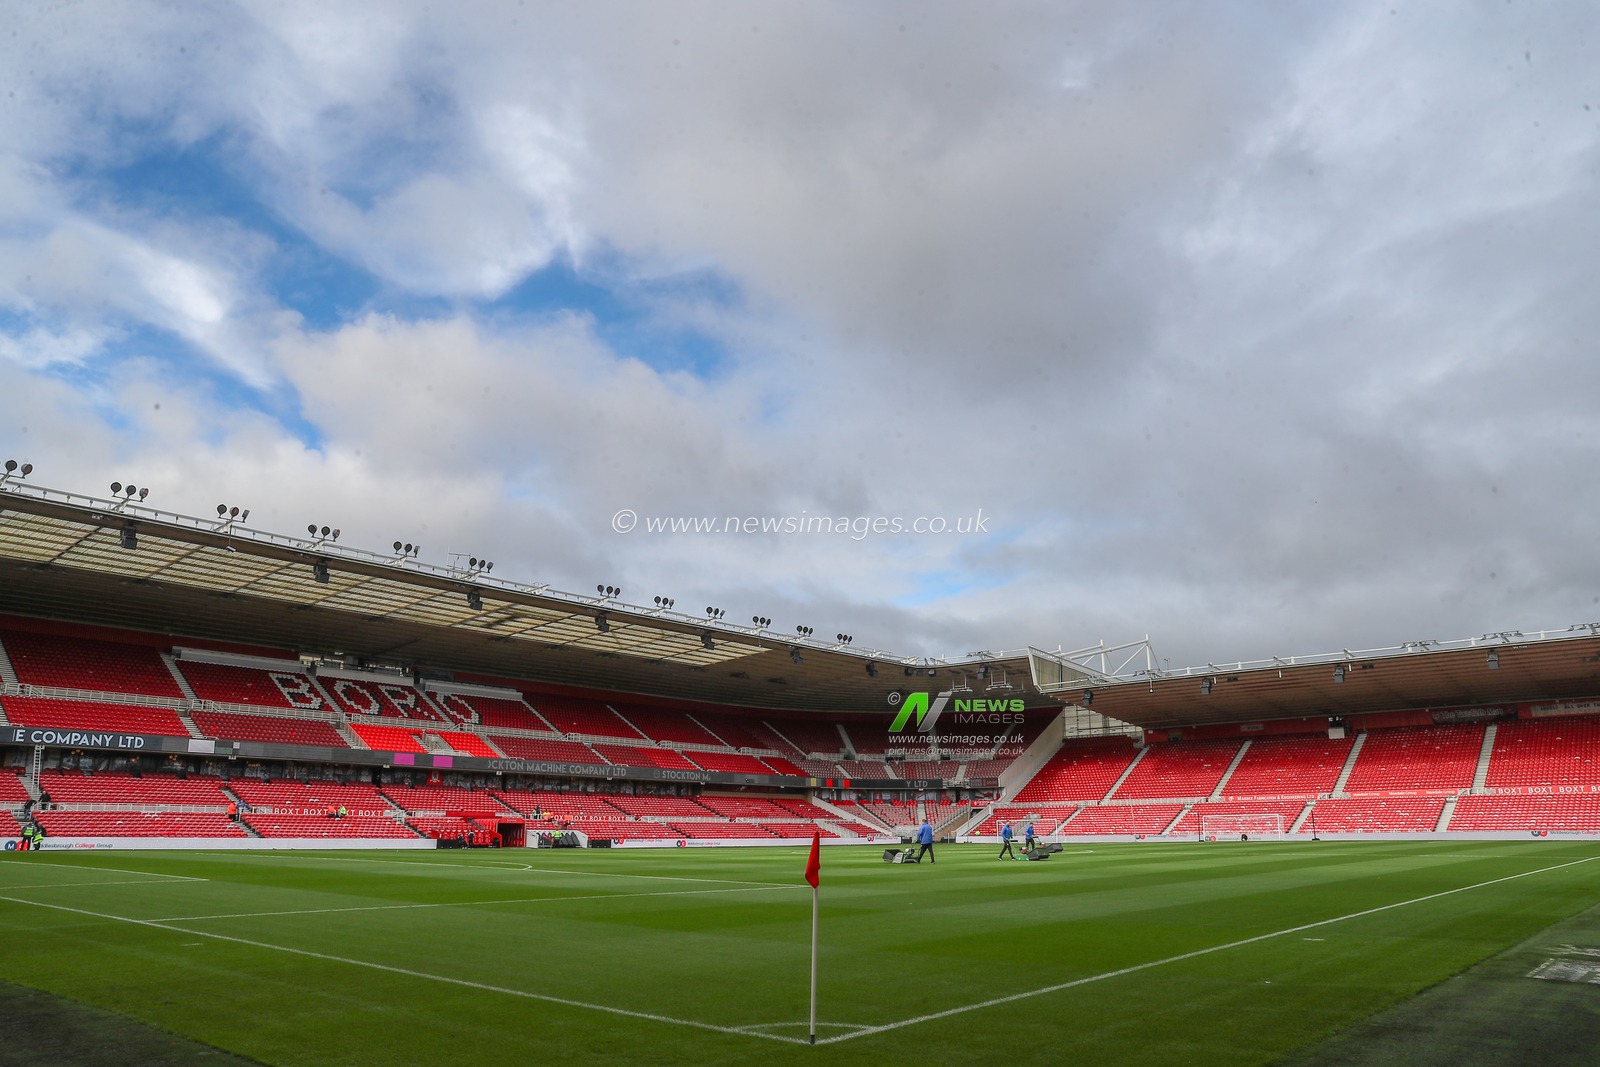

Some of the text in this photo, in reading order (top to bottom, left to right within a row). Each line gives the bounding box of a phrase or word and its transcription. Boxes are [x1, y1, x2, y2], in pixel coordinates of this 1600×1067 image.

[269, 673, 481, 725] BORO
[12, 729, 145, 749] E COMPANY LTD
[526, 762, 567, 775] MACHINE
[569, 765, 610, 777] COMPANY
[612, 767, 627, 777] LTD
[662, 770, 701, 781] STOCKTON
[914, 780, 928, 788] LTD
[274, 807, 300, 815] BOXT
[358, 809, 382, 817] BOXT
[75, 842, 95, 850] College
